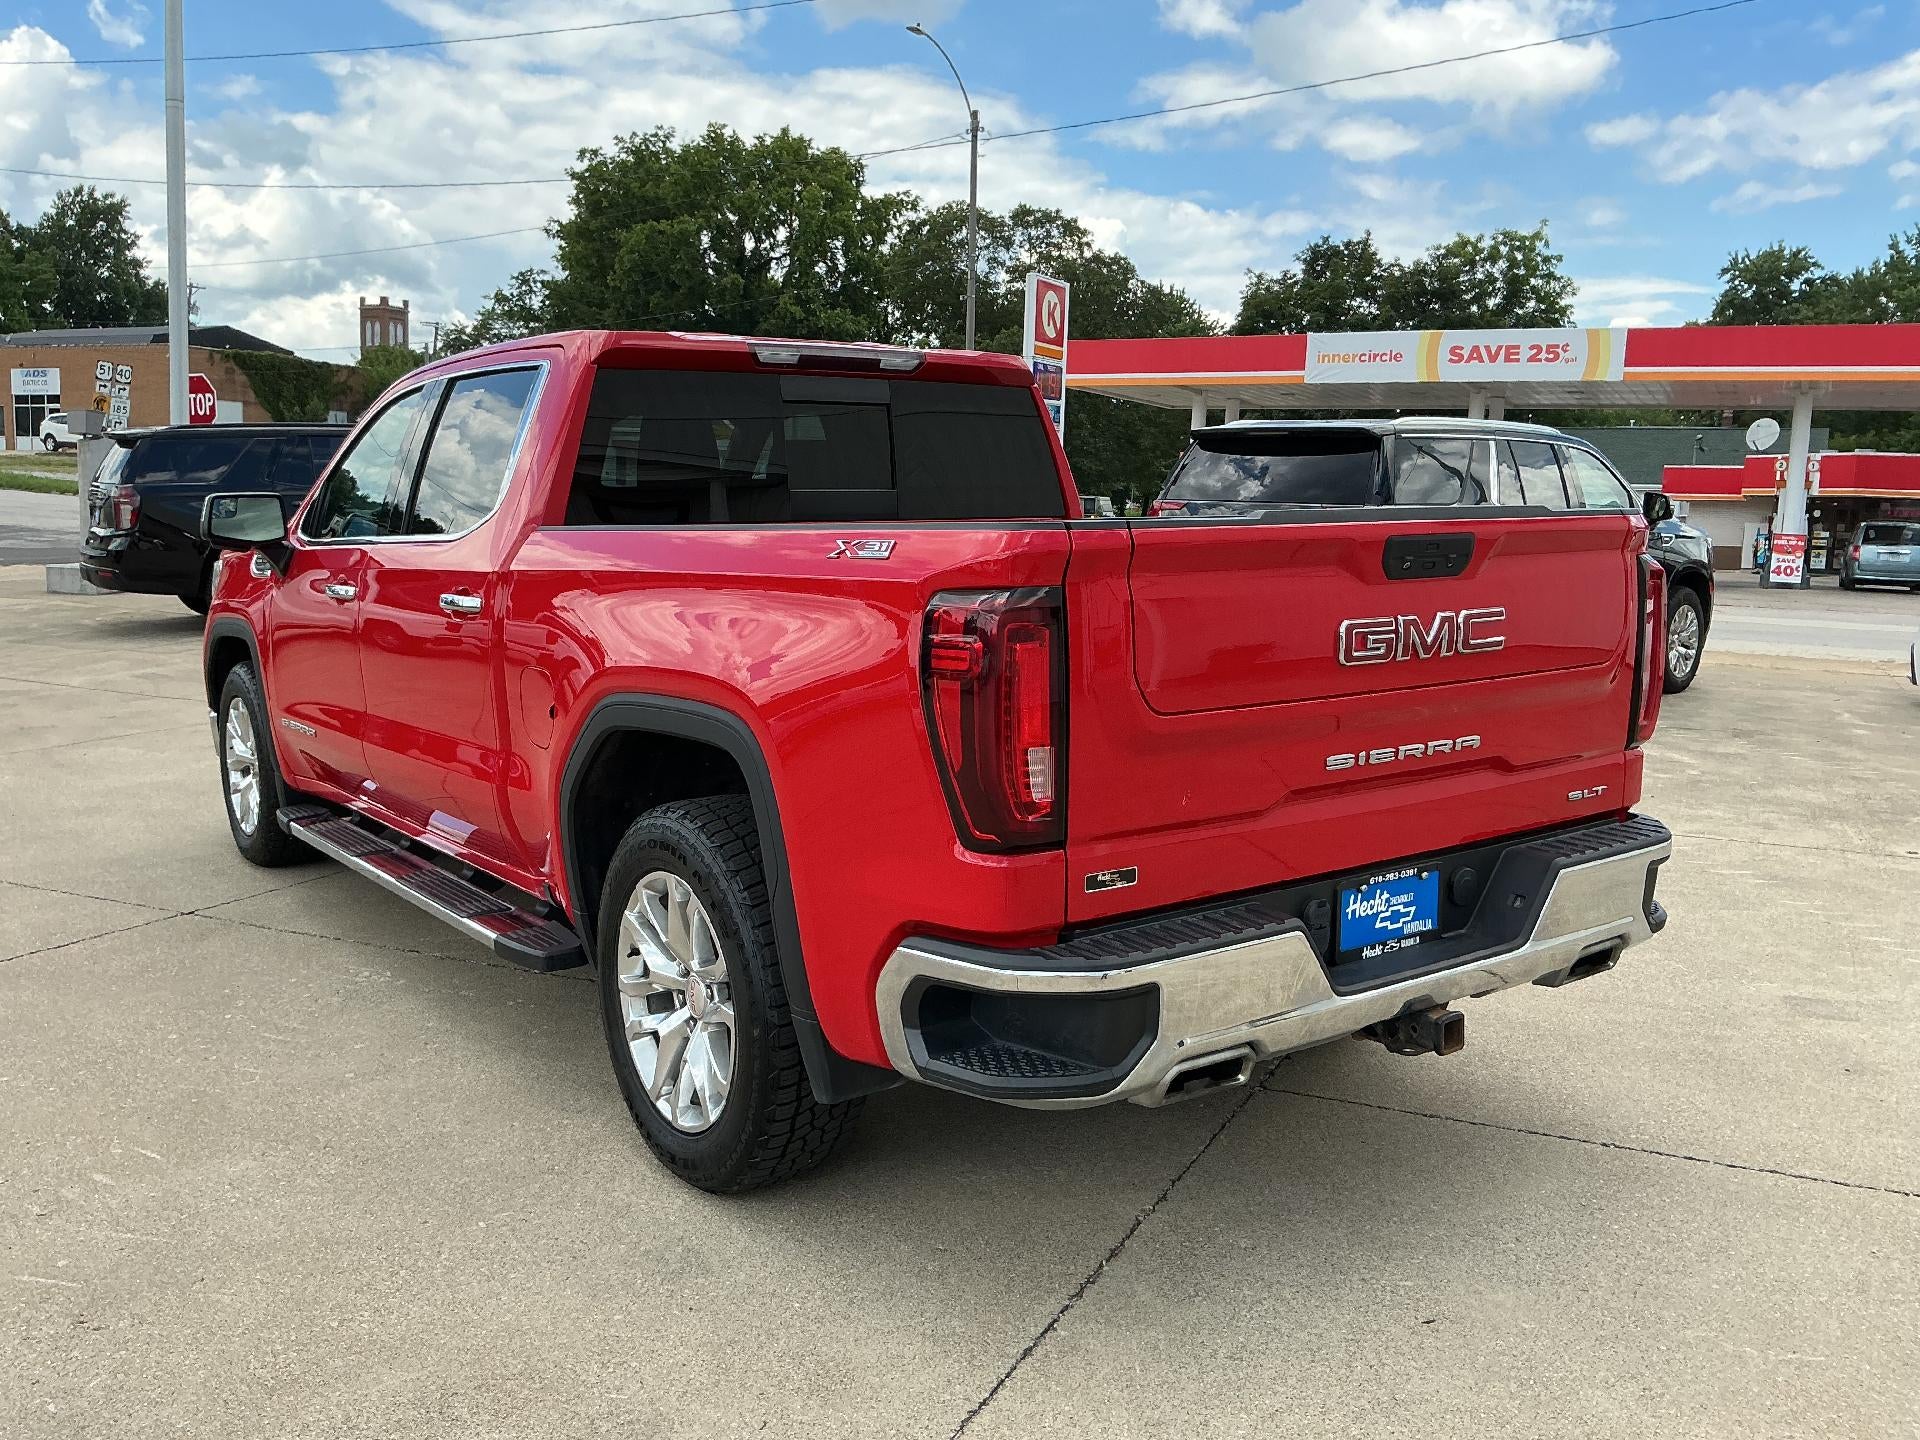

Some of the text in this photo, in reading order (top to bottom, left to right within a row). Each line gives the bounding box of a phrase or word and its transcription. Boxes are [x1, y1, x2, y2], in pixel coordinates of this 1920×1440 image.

[1316, 349, 1403, 364] innercircle
[1447, 344, 1521, 364] SAVE
[24, 369, 48, 378] ADS
[99, 364, 111, 377] 51
[116, 368, 131, 380] 40
[112, 404, 128, 415] 185
[188, 394, 214, 416] TOP
[1339, 607, 1506, 666] GMC
[1325, 735, 1481, 771] SIERRA
[1567, 785, 1608, 801] SLT
[1346, 889, 1390, 920] Hecht
[1403, 918, 1433, 935] VANDALIA
[1361, 943, 1384, 960] Hecht
